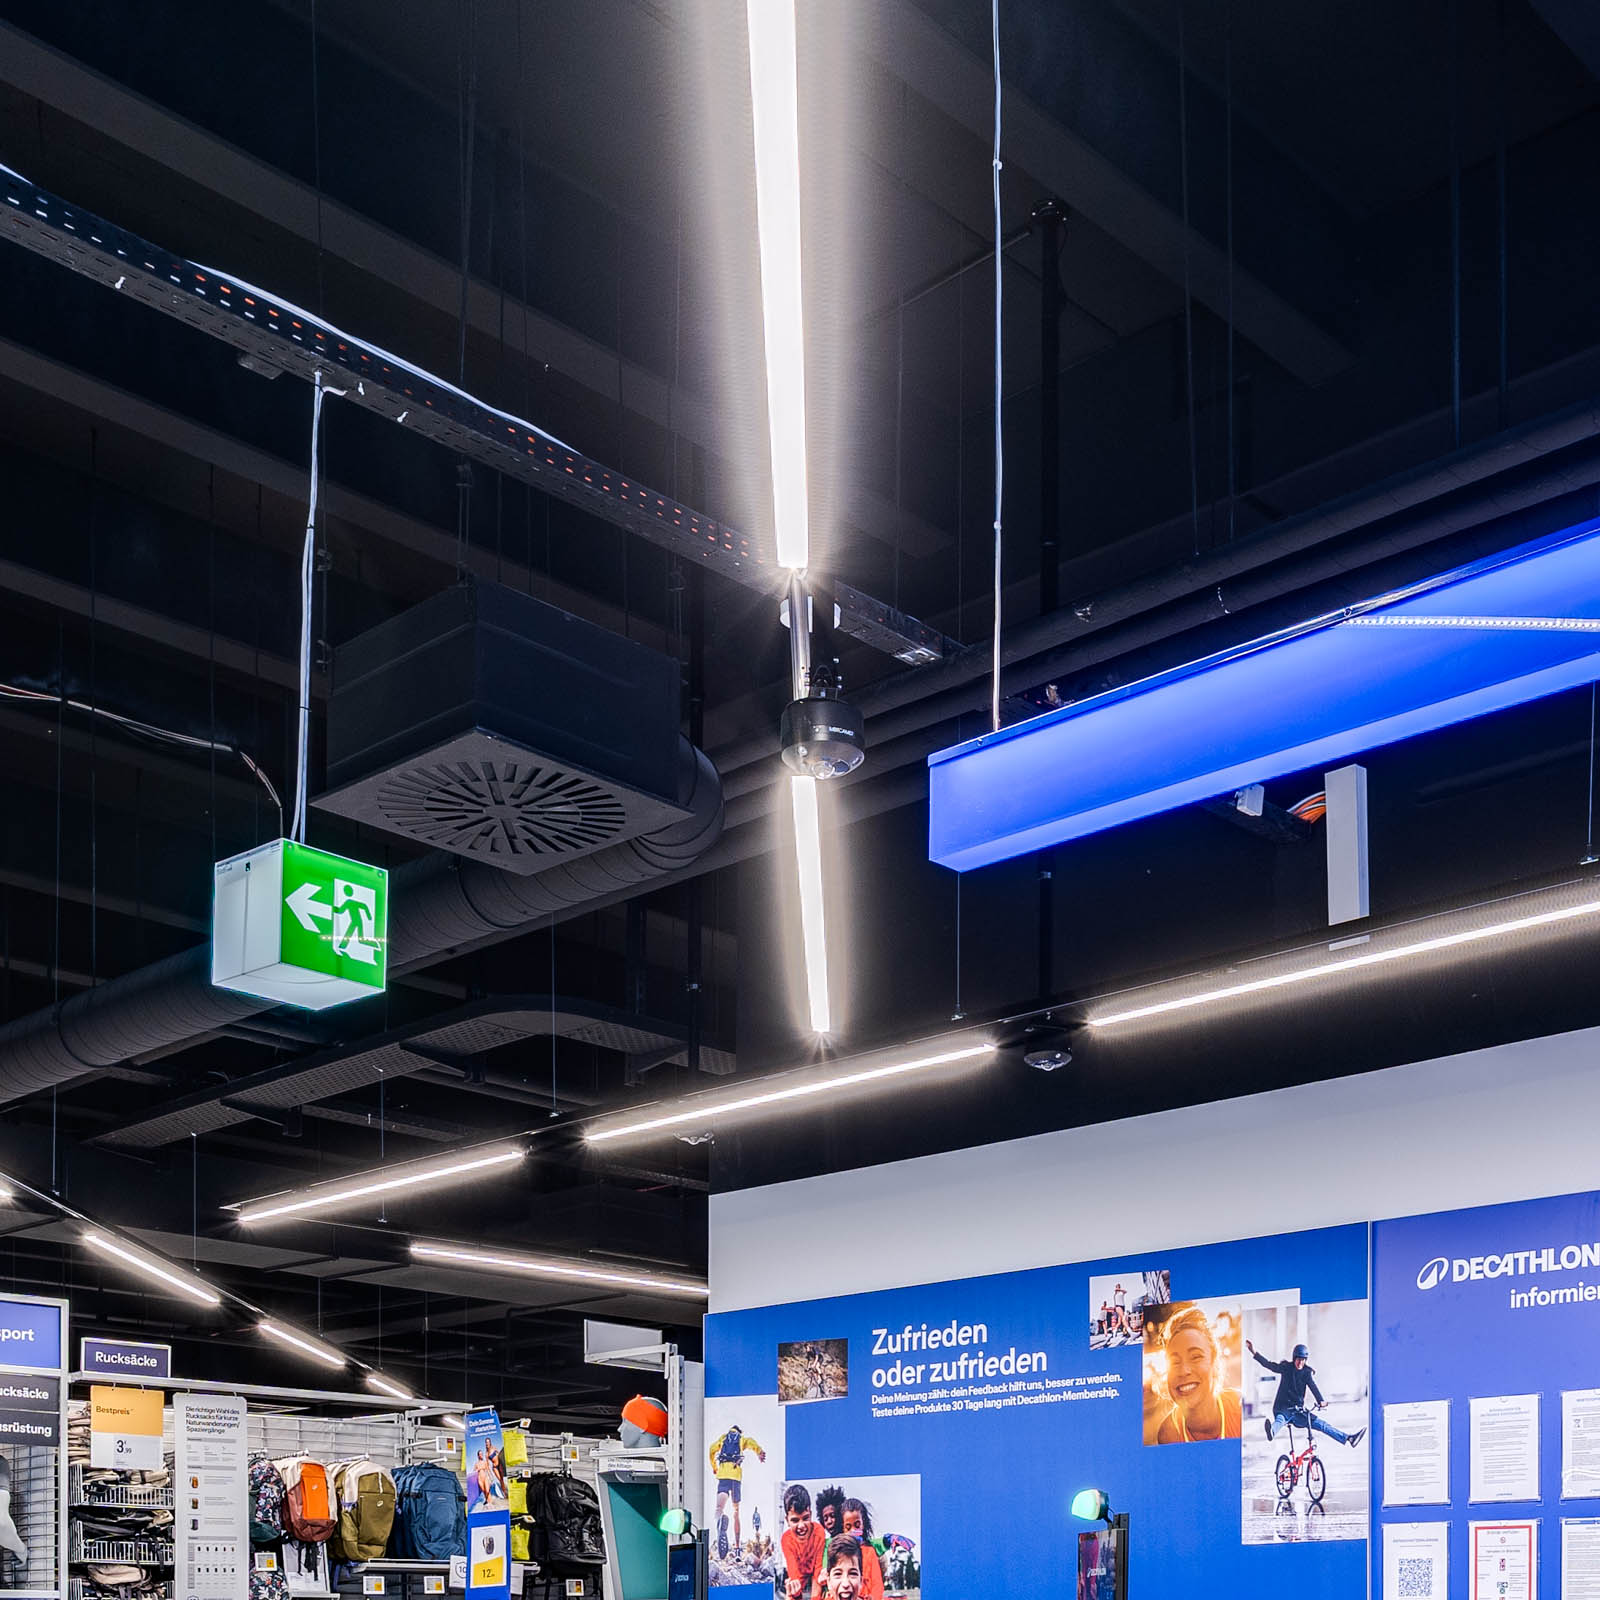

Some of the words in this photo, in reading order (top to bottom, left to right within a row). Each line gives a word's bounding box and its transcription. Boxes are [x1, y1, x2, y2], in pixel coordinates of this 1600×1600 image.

[1452, 1242, 1600, 1282] DECATHLON
[872, 1320, 988, 1356] Zufrieden
[95, 1351, 158, 1368] Rucksäcke
[871, 1360, 926, 1388] oder
[929, 1347, 1048, 1383] zufrieden
[872, 1394, 894, 1405] Deine
[894, 1391, 928, 1403] Meinung
[927, 1388, 950, 1400] zählt:
[950, 1386, 968, 1398] dein
[968, 1383, 1009, 1396] Feedback
[1008, 1381, 1026, 1392] hilft
[1026, 1381, 1045, 1391] uns,
[1045, 1378, 1075, 1389] besser
[1075, 1377, 1086, 1386] zu
[1086, 1372, 1123, 1385] werden.
[872, 1407, 893, 1418] Teste
[893, 1405, 914, 1416] deine
[914, 1401, 952, 1414] Produkte
[952, 1400, 964, 1411] 30
[964, 1399, 984, 1411] Tage
[984, 1398, 1002, 1409] lang
[1002, 1395, 1017, 1407] mit
[1017, 1386, 1120, 1405] Decathlon-Membership.
